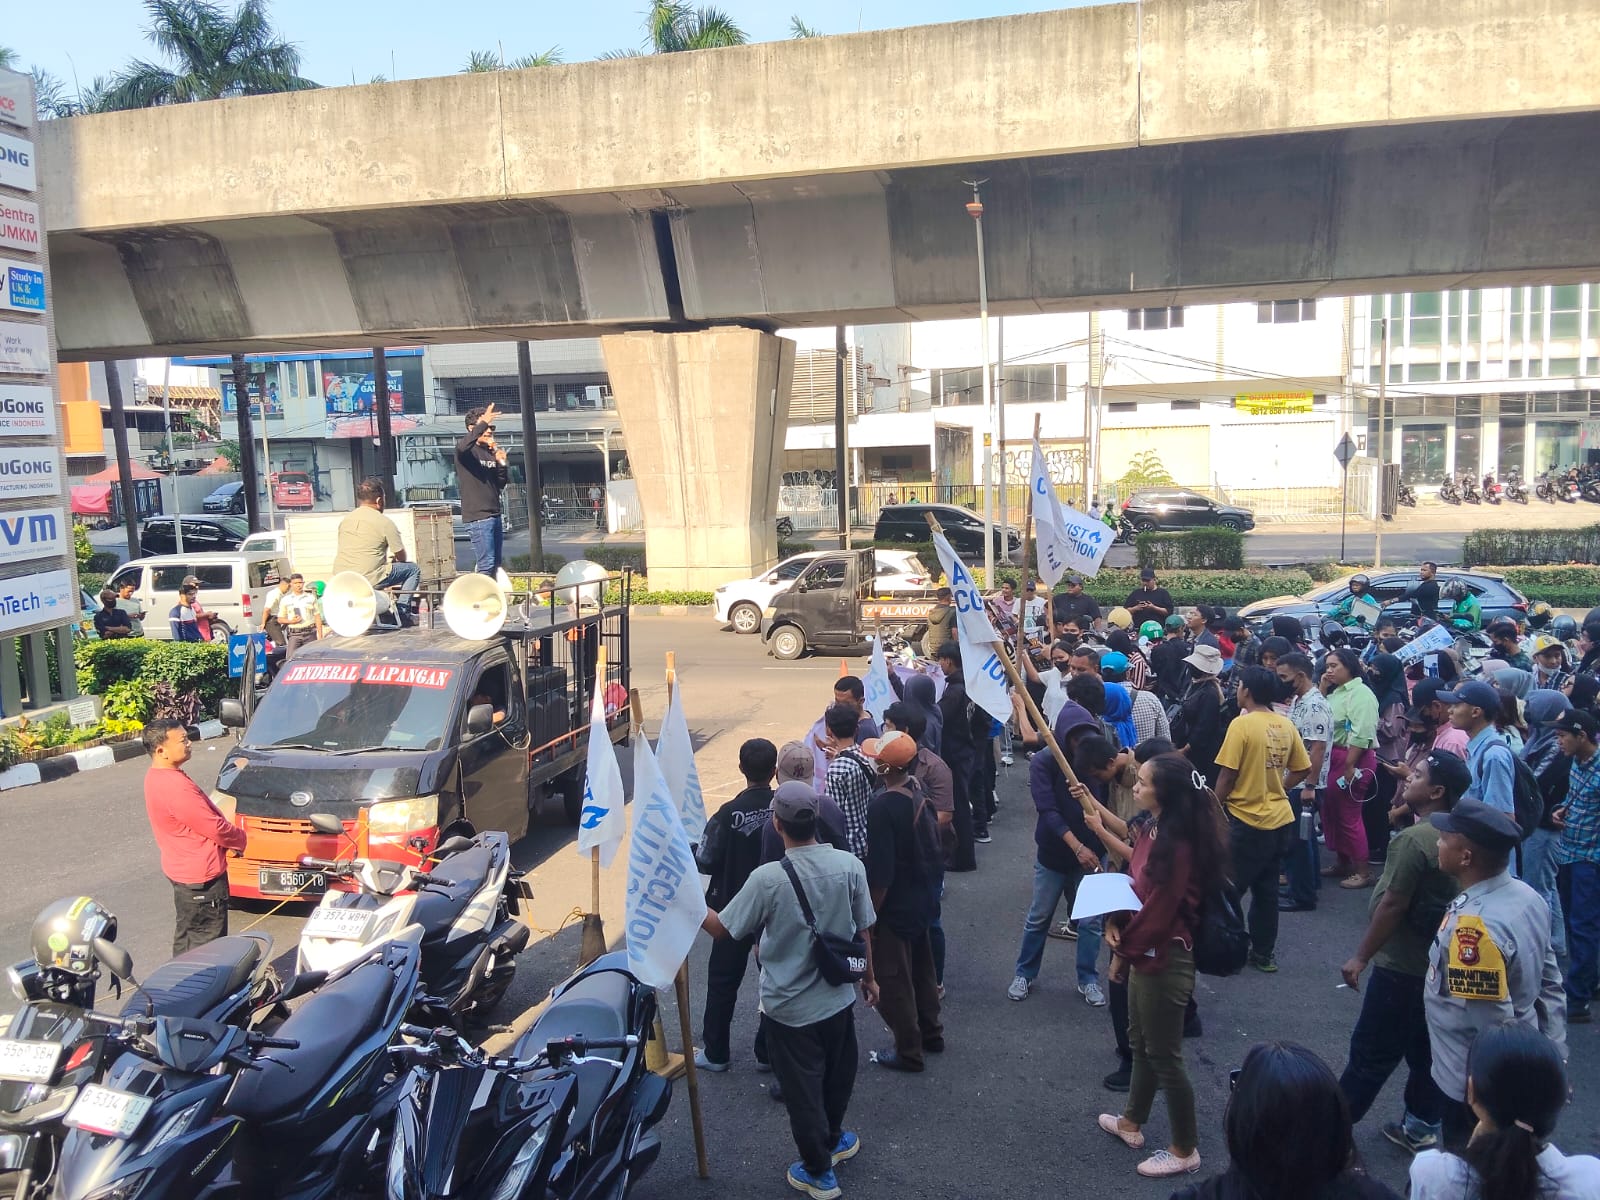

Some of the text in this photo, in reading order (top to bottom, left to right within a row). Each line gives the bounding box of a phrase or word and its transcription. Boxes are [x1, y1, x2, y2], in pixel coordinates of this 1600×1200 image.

[0, 95, 15, 111] ce
[11, 270, 42, 285] Study in
[12, 282, 31, 294] UK &
[13, 294, 40, 306] Ireland
[5, 336, 22, 345] Work
[1069, 537, 1098, 559] TION
[875, 600, 933, 617] ALAMOV
[286, 665, 449, 686] JENDERAL LAPANGAN
[280, 872, 305, 886] 8560
